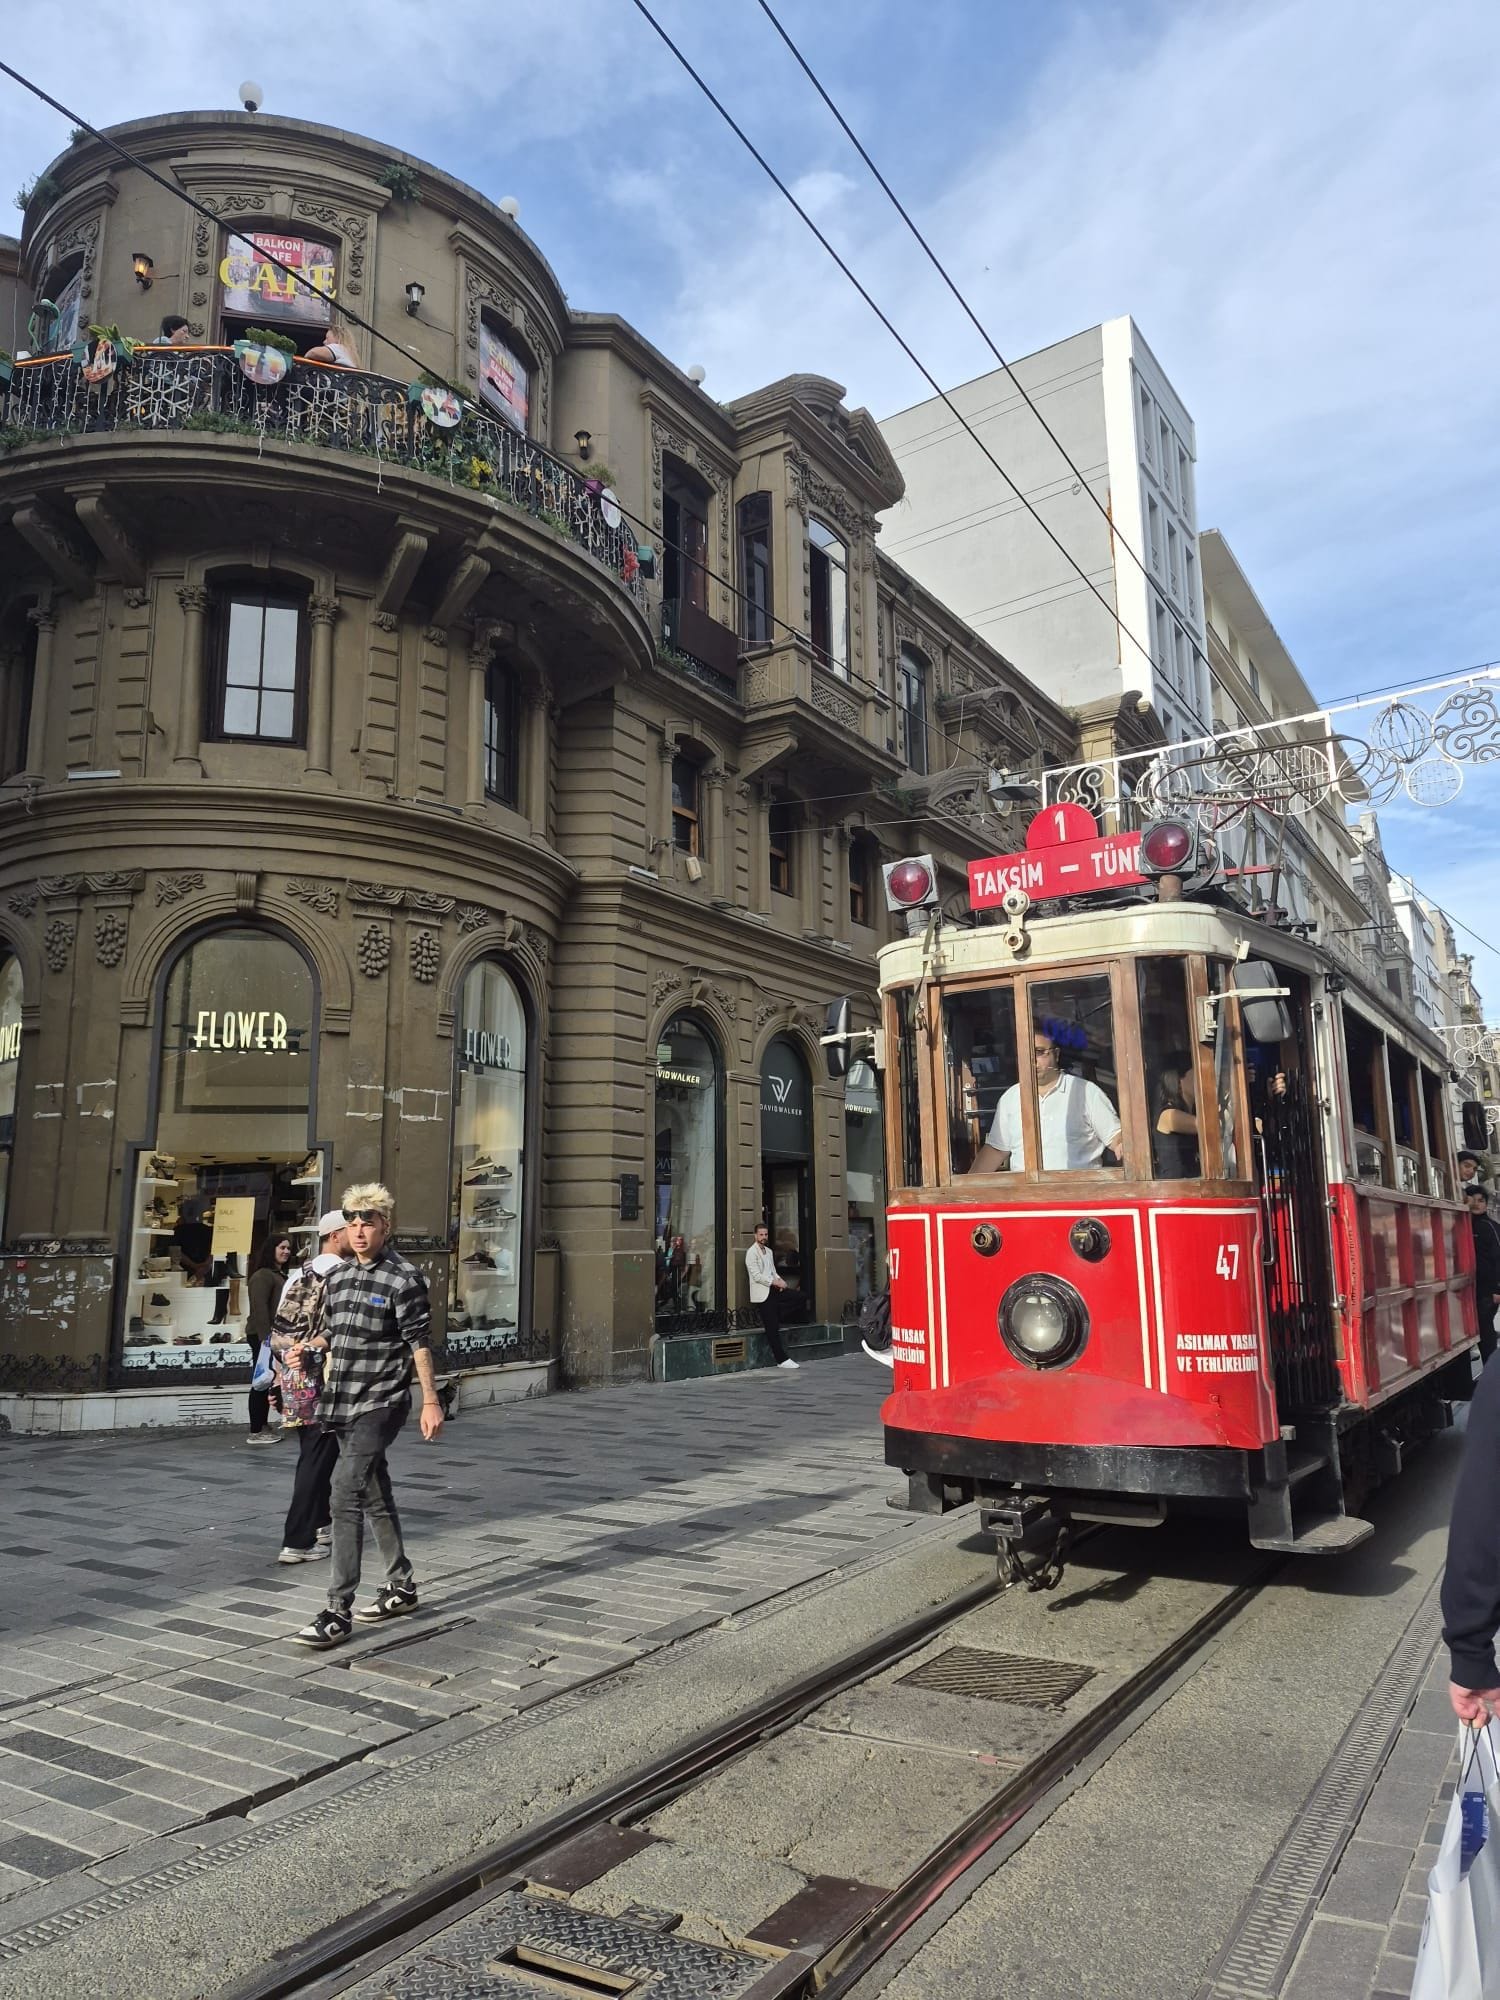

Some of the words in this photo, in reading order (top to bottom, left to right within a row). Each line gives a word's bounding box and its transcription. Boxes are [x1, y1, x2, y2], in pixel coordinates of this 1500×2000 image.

[256, 237, 301, 252] BALKON
[264, 249, 293, 263] AFE
[1054, 810, 1067, 842] 1
[973, 858, 1044, 897] TAKSİM
[193, 1011, 288, 1049] FLOWER
[464, 1028, 512, 1069] FLOWER
[1216, 1244, 1240, 1281] 47
[1176, 1333, 1229, 1351] ASILMAK
[1176, 1355, 1193, 1373] VE
